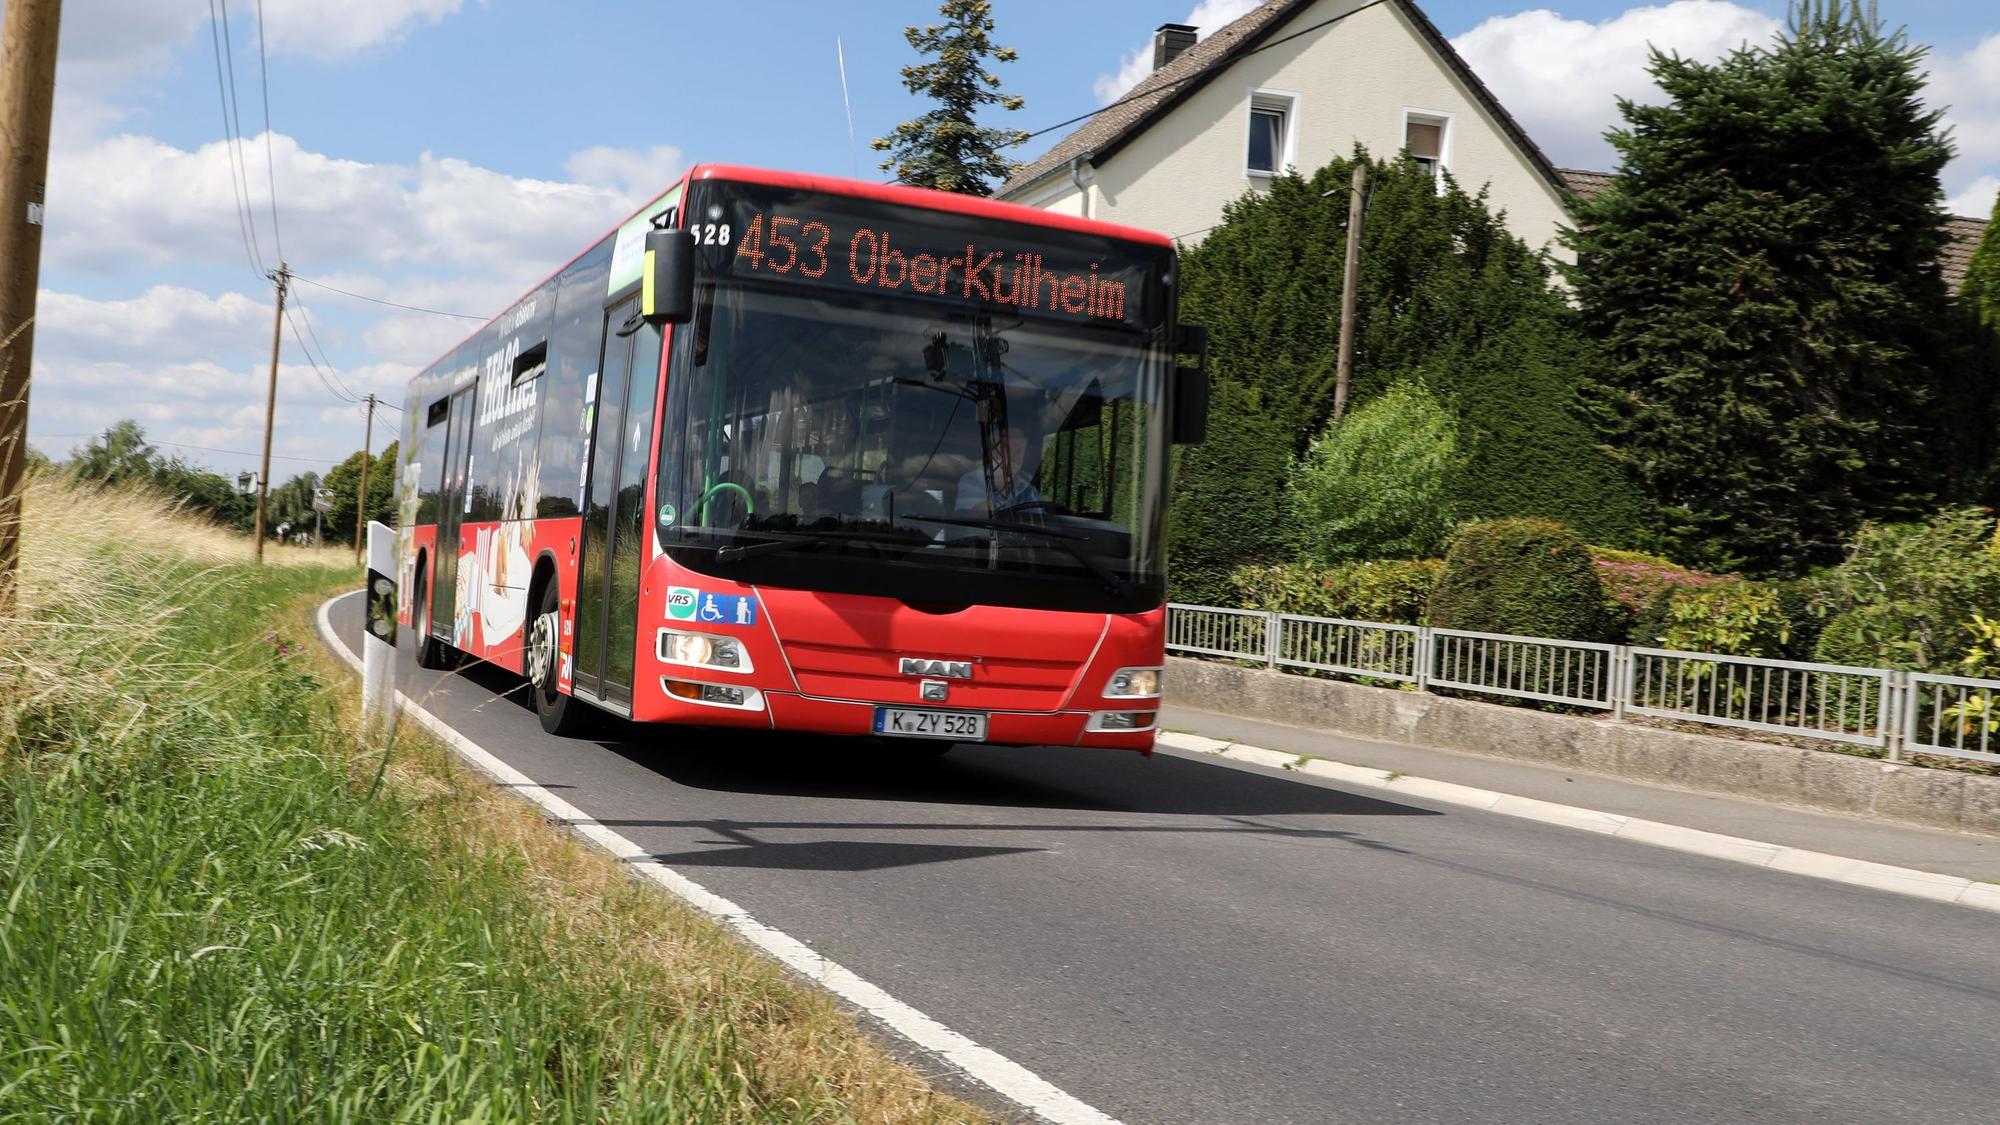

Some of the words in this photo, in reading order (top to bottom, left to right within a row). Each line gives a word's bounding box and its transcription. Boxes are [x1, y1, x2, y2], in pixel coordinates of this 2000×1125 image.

[691, 223, 731, 247] 528
[736, 212, 830, 279] 453
[668, 593, 690, 606] VRS
[898, 657, 973, 680] MAN
[892, 711, 904, 731] K
[916, 713, 940, 732] ZY
[944, 715, 977, 735] 528
